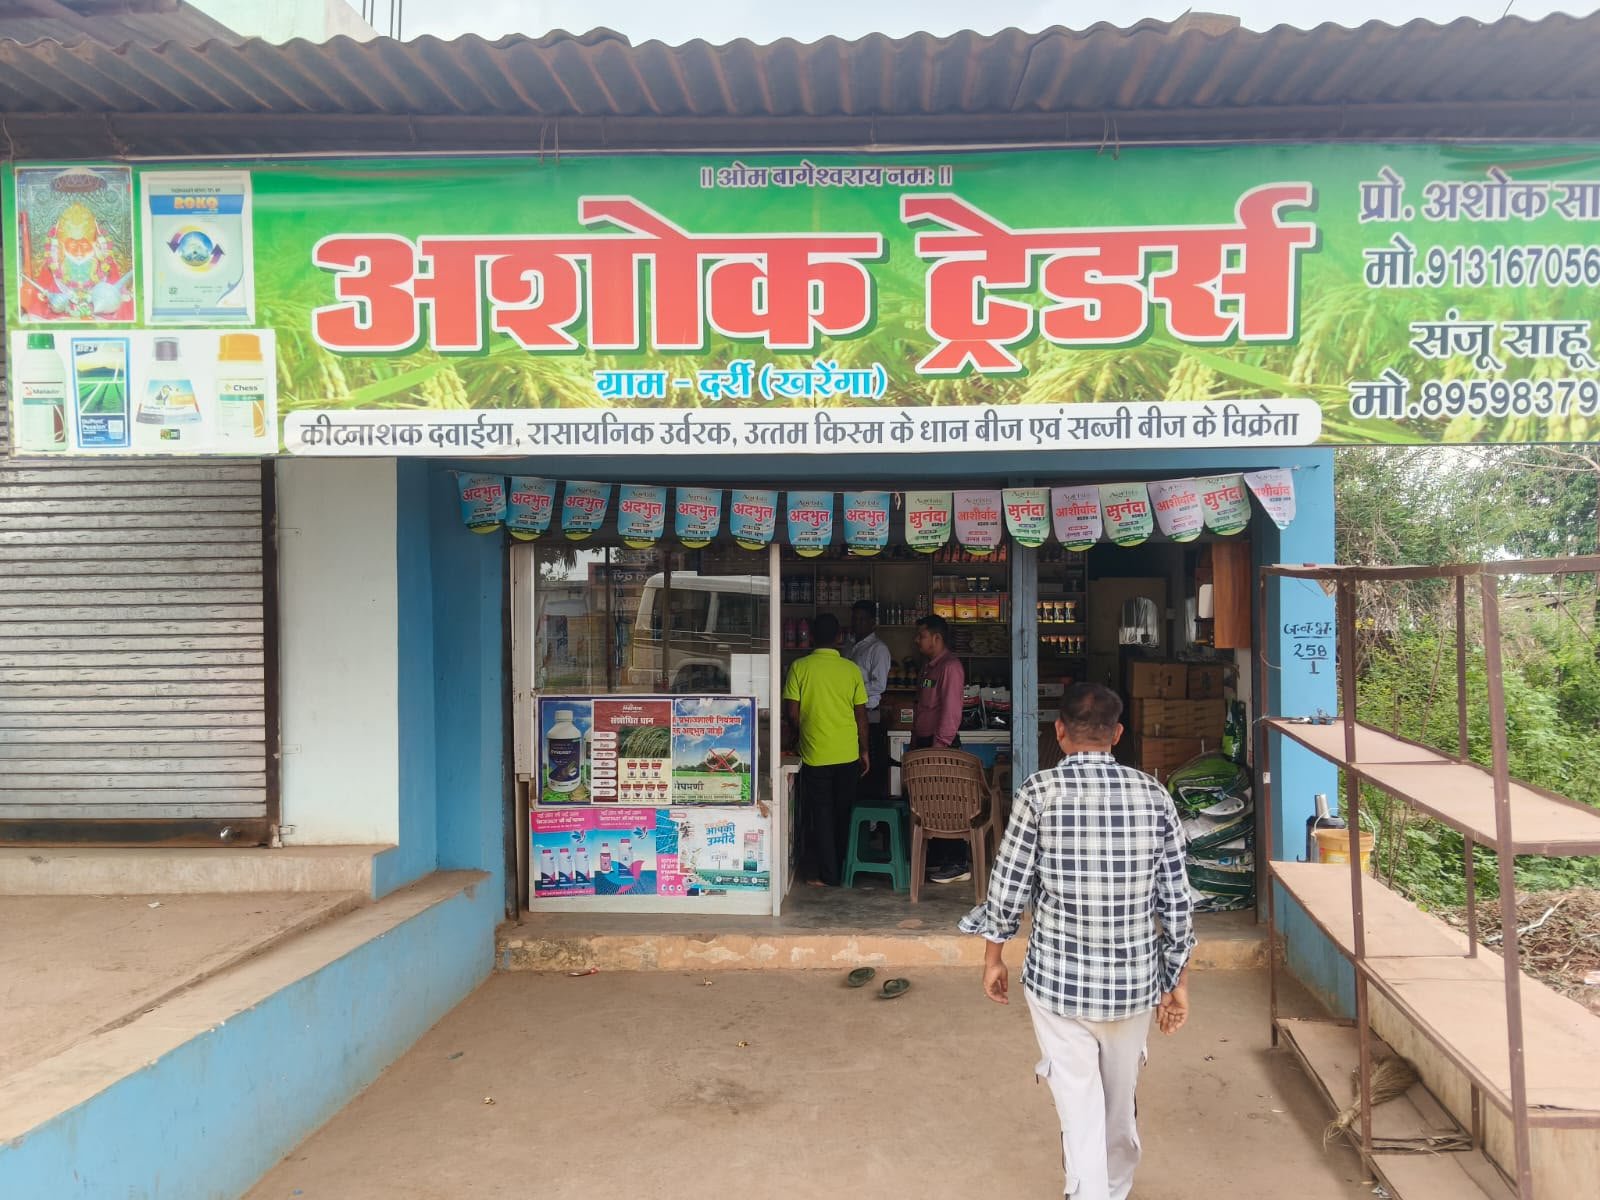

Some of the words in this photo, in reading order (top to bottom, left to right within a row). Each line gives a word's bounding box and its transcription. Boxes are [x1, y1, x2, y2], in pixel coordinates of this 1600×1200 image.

[717, 160, 769, 188] ओम
[772, 159, 883, 188] बागेश्वराय
[1359, 166, 1414, 222] प्रो.
[1422, 167, 1549, 222] अशोक
[312, 195, 886, 353] अशोक
[900, 182, 1318, 375] ट्रेडर्स
[1410, 308, 1504, 369] संजू
[1503, 320, 1598, 369] साहू
[233, 384, 258, 392] Chess
[594, 371, 665, 398] ग्राम
[758, 361, 887, 399] (खरेंगा)
[300, 414, 422, 446] कीटनाशक
[527, 412, 654, 445] रासायनिक
[660, 412, 737, 448] उर्वरक,
[744, 421, 809, 445] उत्तम
[814, 411, 884, 445] किस्म
[890, 411, 914, 443] के
[920, 420, 969, 443] धान
[975, 409, 1023, 442] बीज
[1029, 408, 1065, 444] एवं
[1067, 406, 1133, 440] सब्जी
[1137, 405, 1186, 438] बीज
[1192, 404, 1217, 438] के
[1223, 403, 1299, 437] विक्रेता
[1007, 500, 1046, 522] सुनंदा
[1105, 498, 1147, 522] सुनंदा
[1203, 485, 1245, 511] सुनंदा
[909, 506, 947, 528] सुनंदा
[1293, 643, 1327, 657] 258
